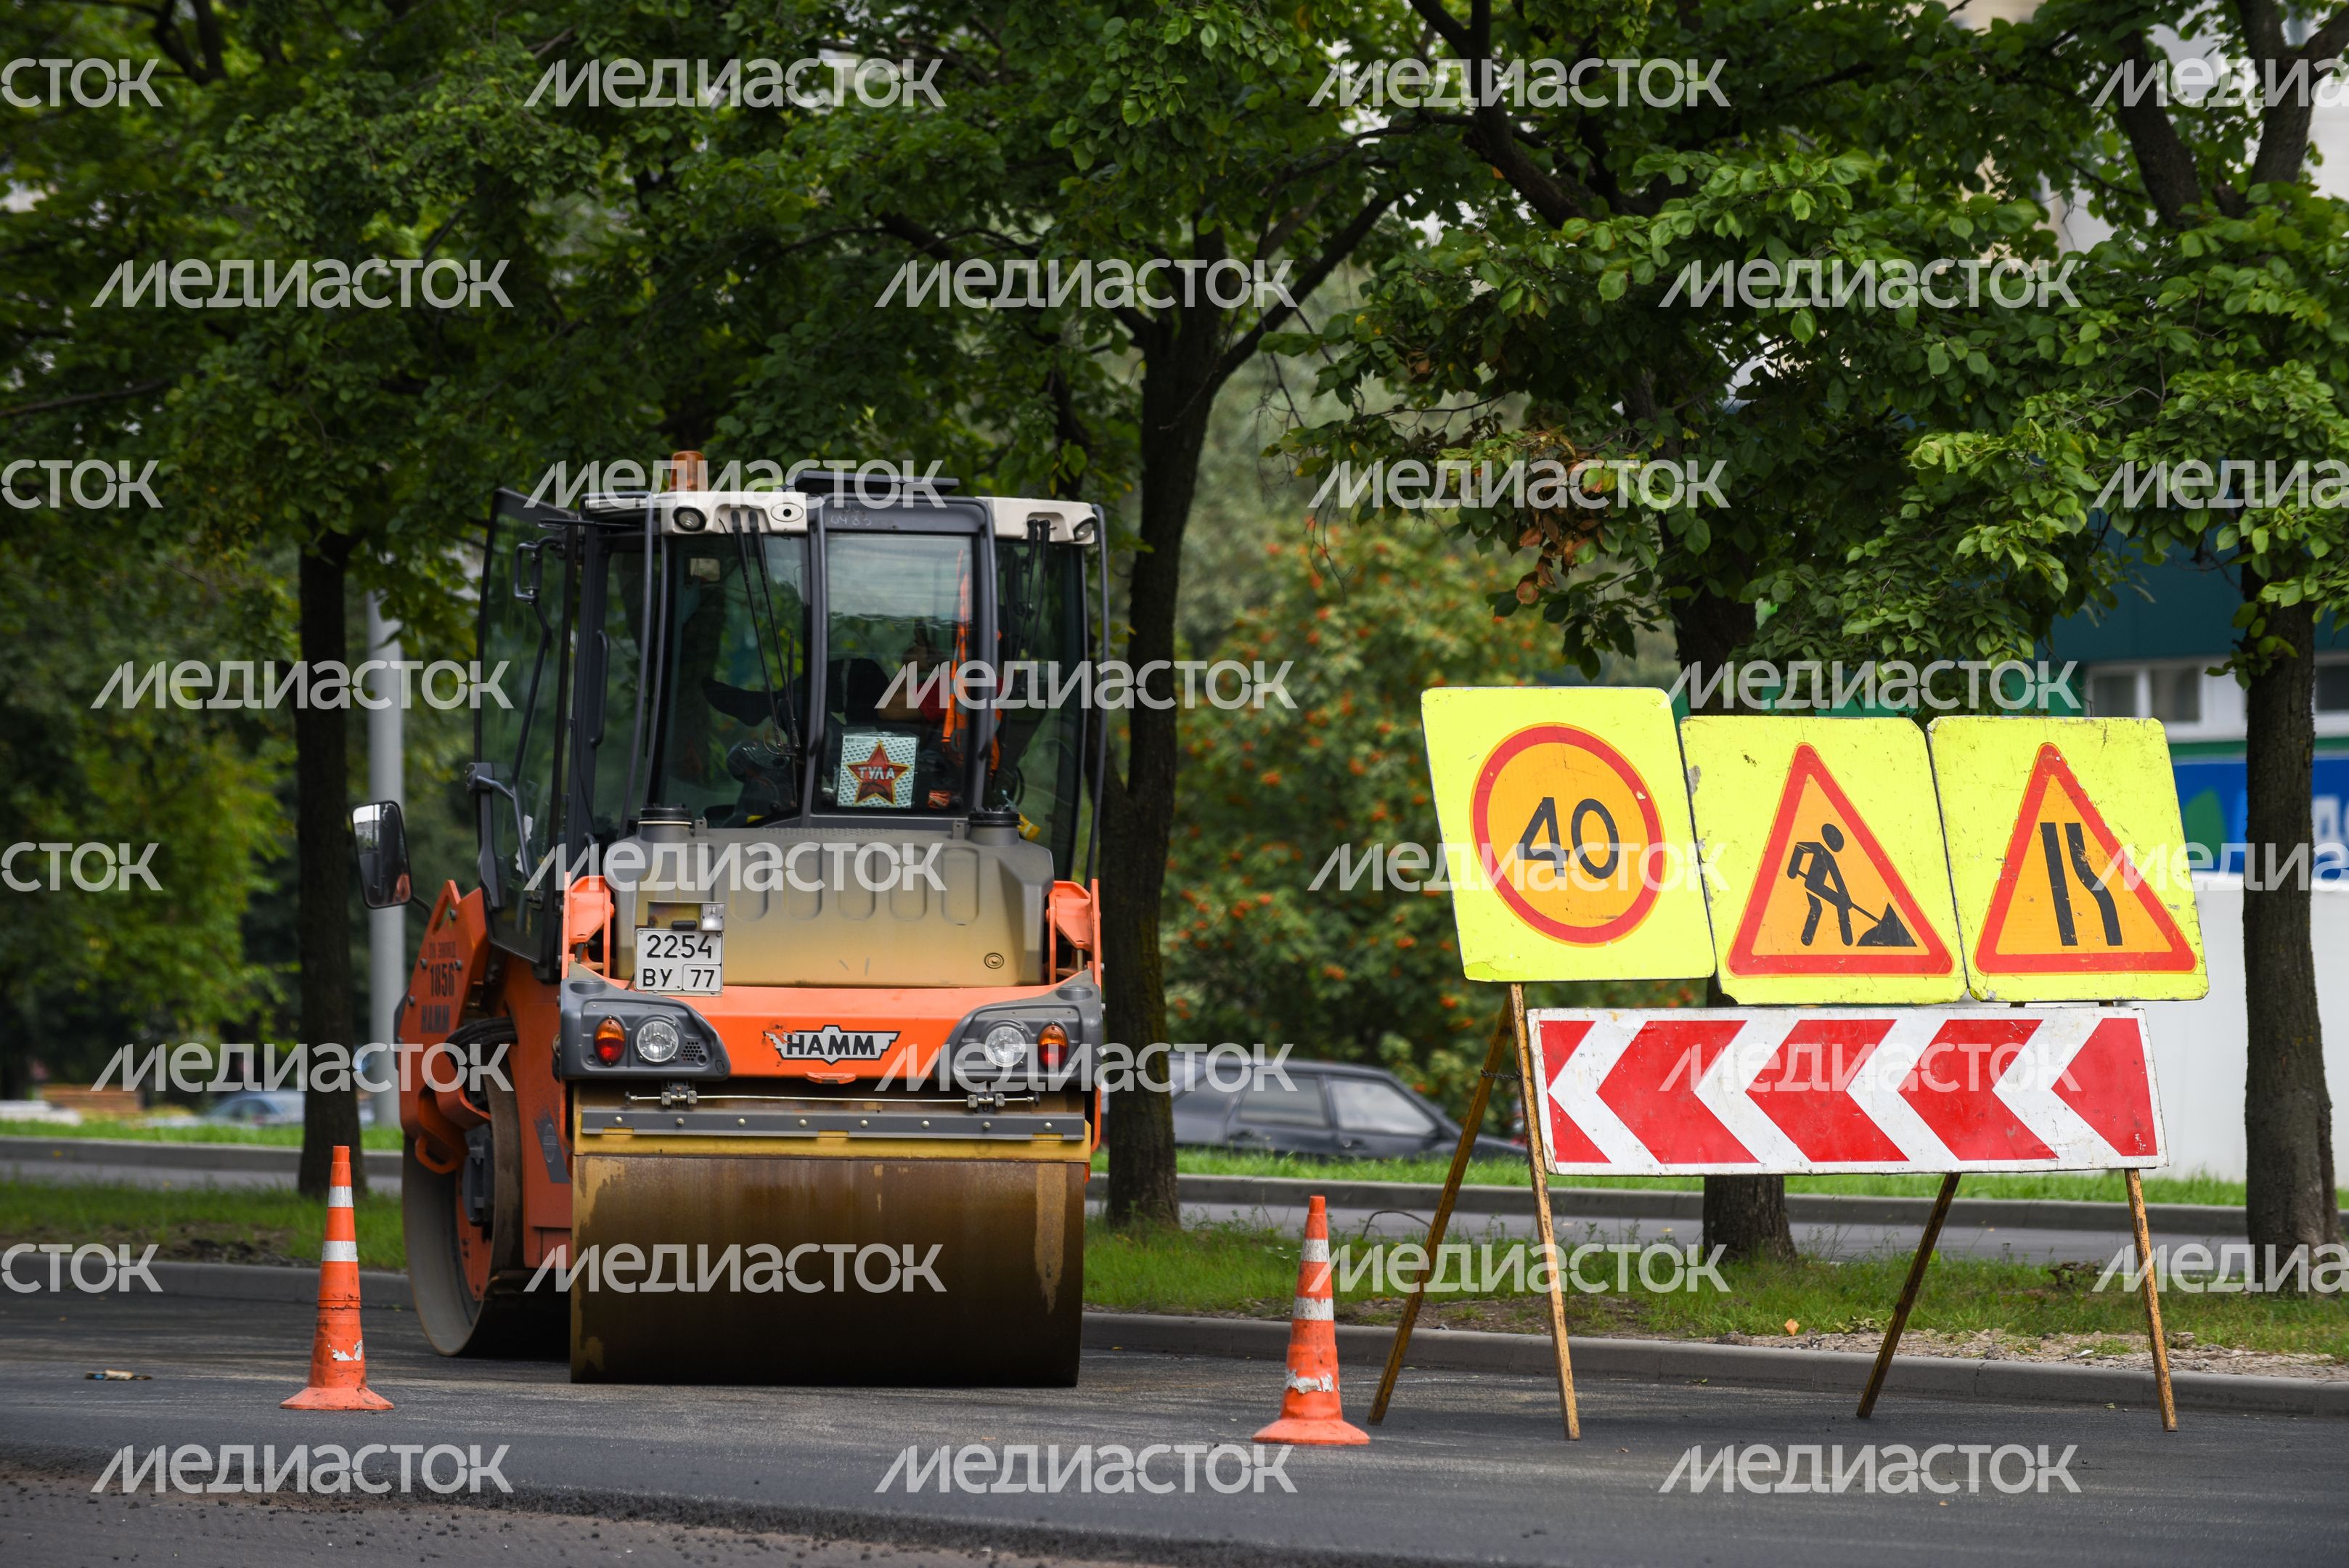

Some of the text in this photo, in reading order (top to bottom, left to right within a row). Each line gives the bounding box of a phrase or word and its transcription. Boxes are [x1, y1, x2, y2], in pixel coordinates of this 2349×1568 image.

[858, 766, 896, 780] ТУЛА
[1516, 796, 1620, 880] 40
[647, 934, 712, 959] 2254
[430, 963, 455, 998] 1856
[690, 969, 715, 988] 77
[786, 1034, 876, 1056] HAMM
